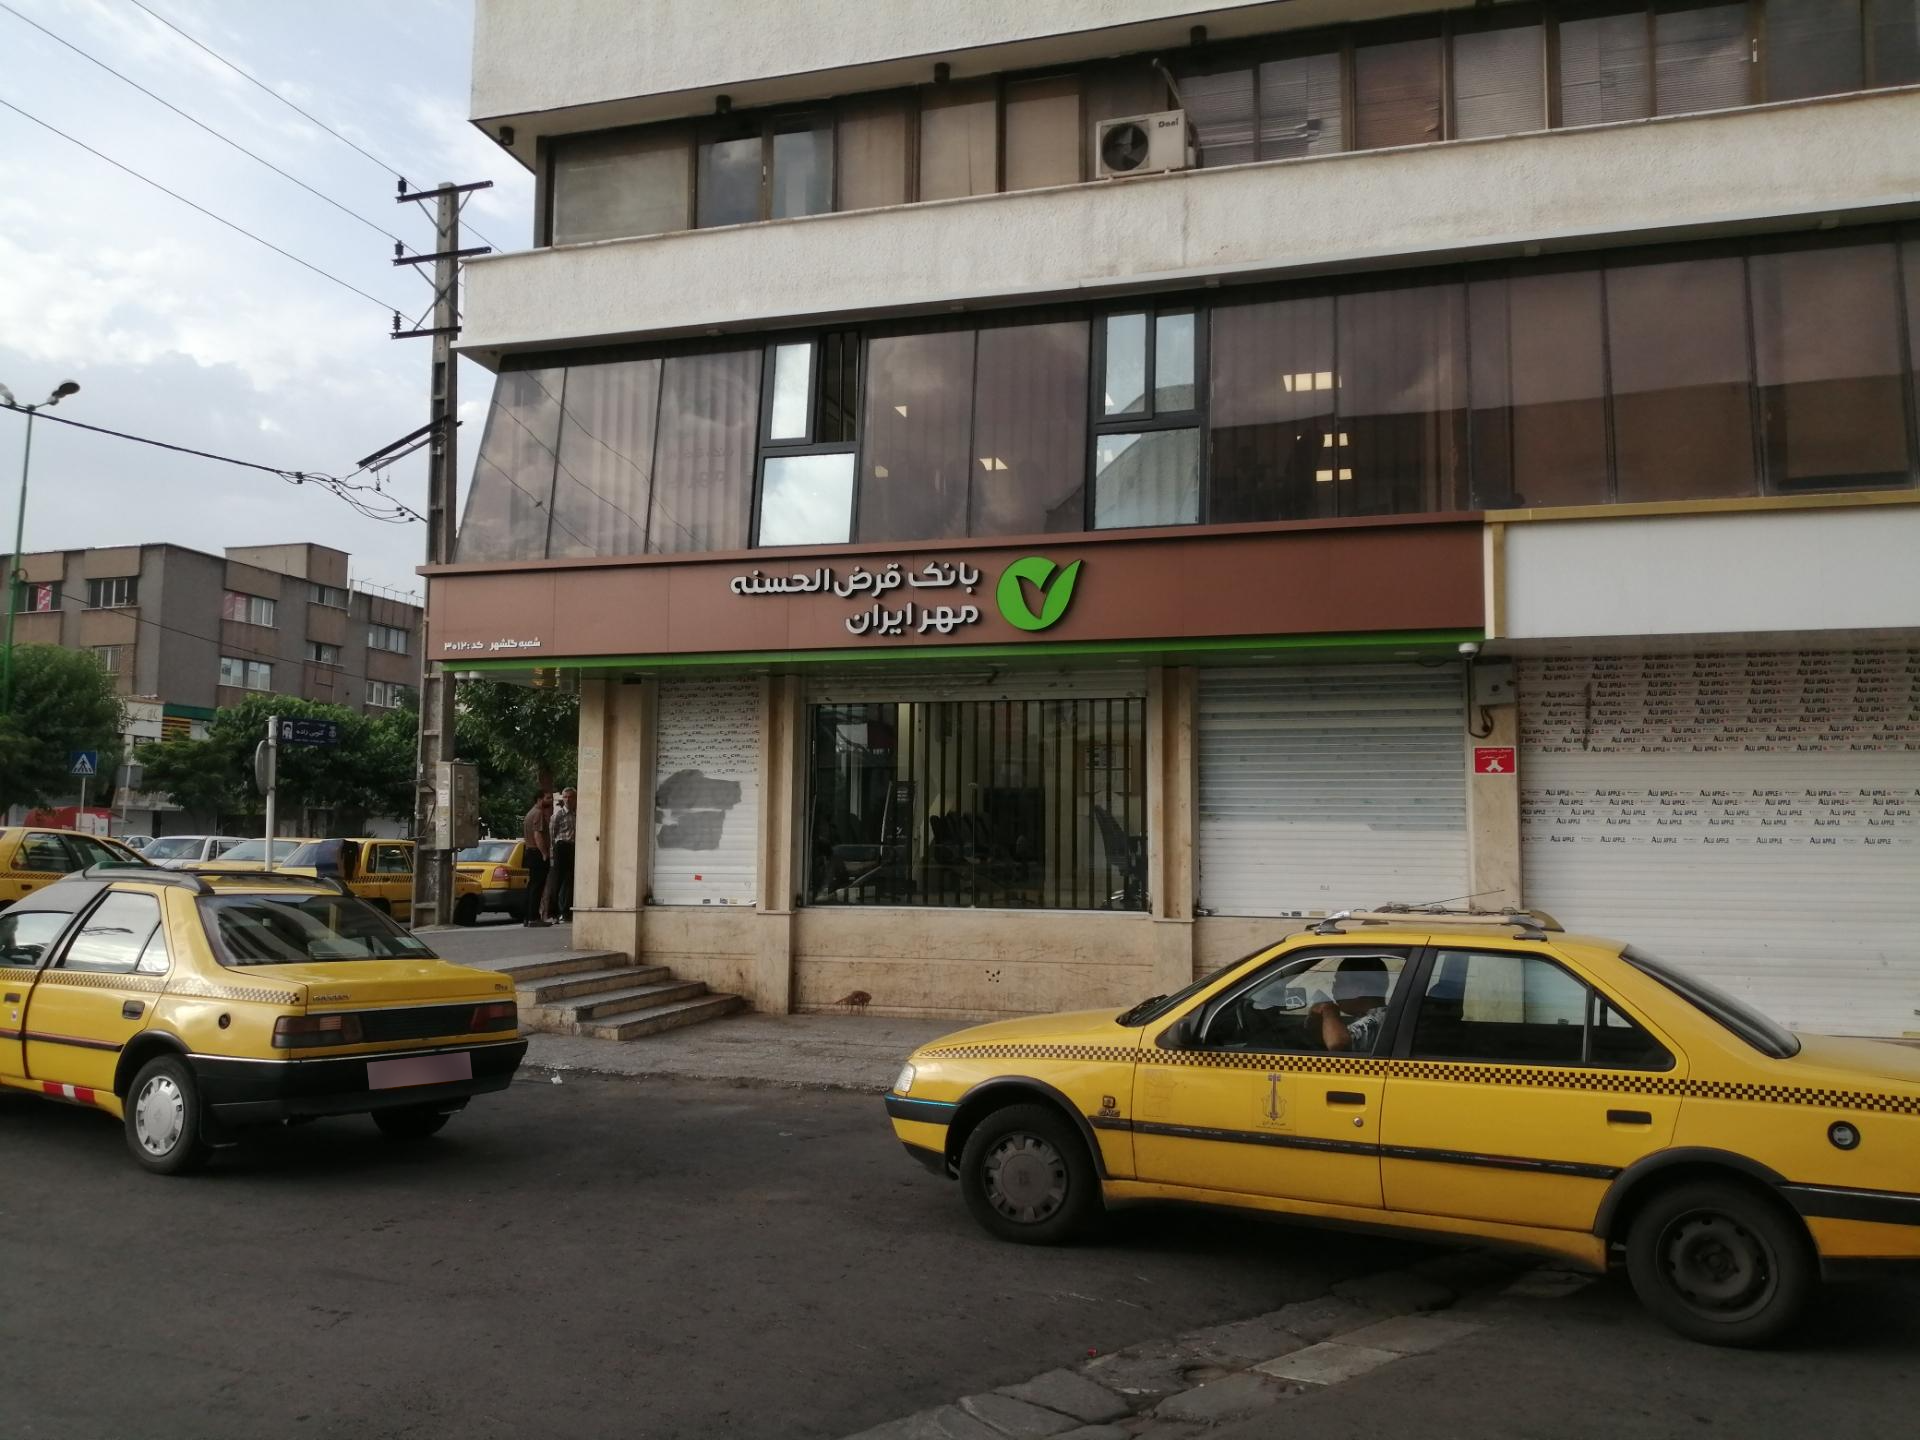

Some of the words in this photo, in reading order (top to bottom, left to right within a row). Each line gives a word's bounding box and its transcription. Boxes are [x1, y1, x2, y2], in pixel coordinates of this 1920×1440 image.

[729, 567, 830, 595] الحسنه
[834, 562, 901, 597] قرض
[908, 561, 979, 594] بانک
[845, 602, 913, 634] ایران
[917, 603, 979, 633] مهر
[489, 638, 518, 651] گلشهر
[518, 637, 541, 650] شعبه
